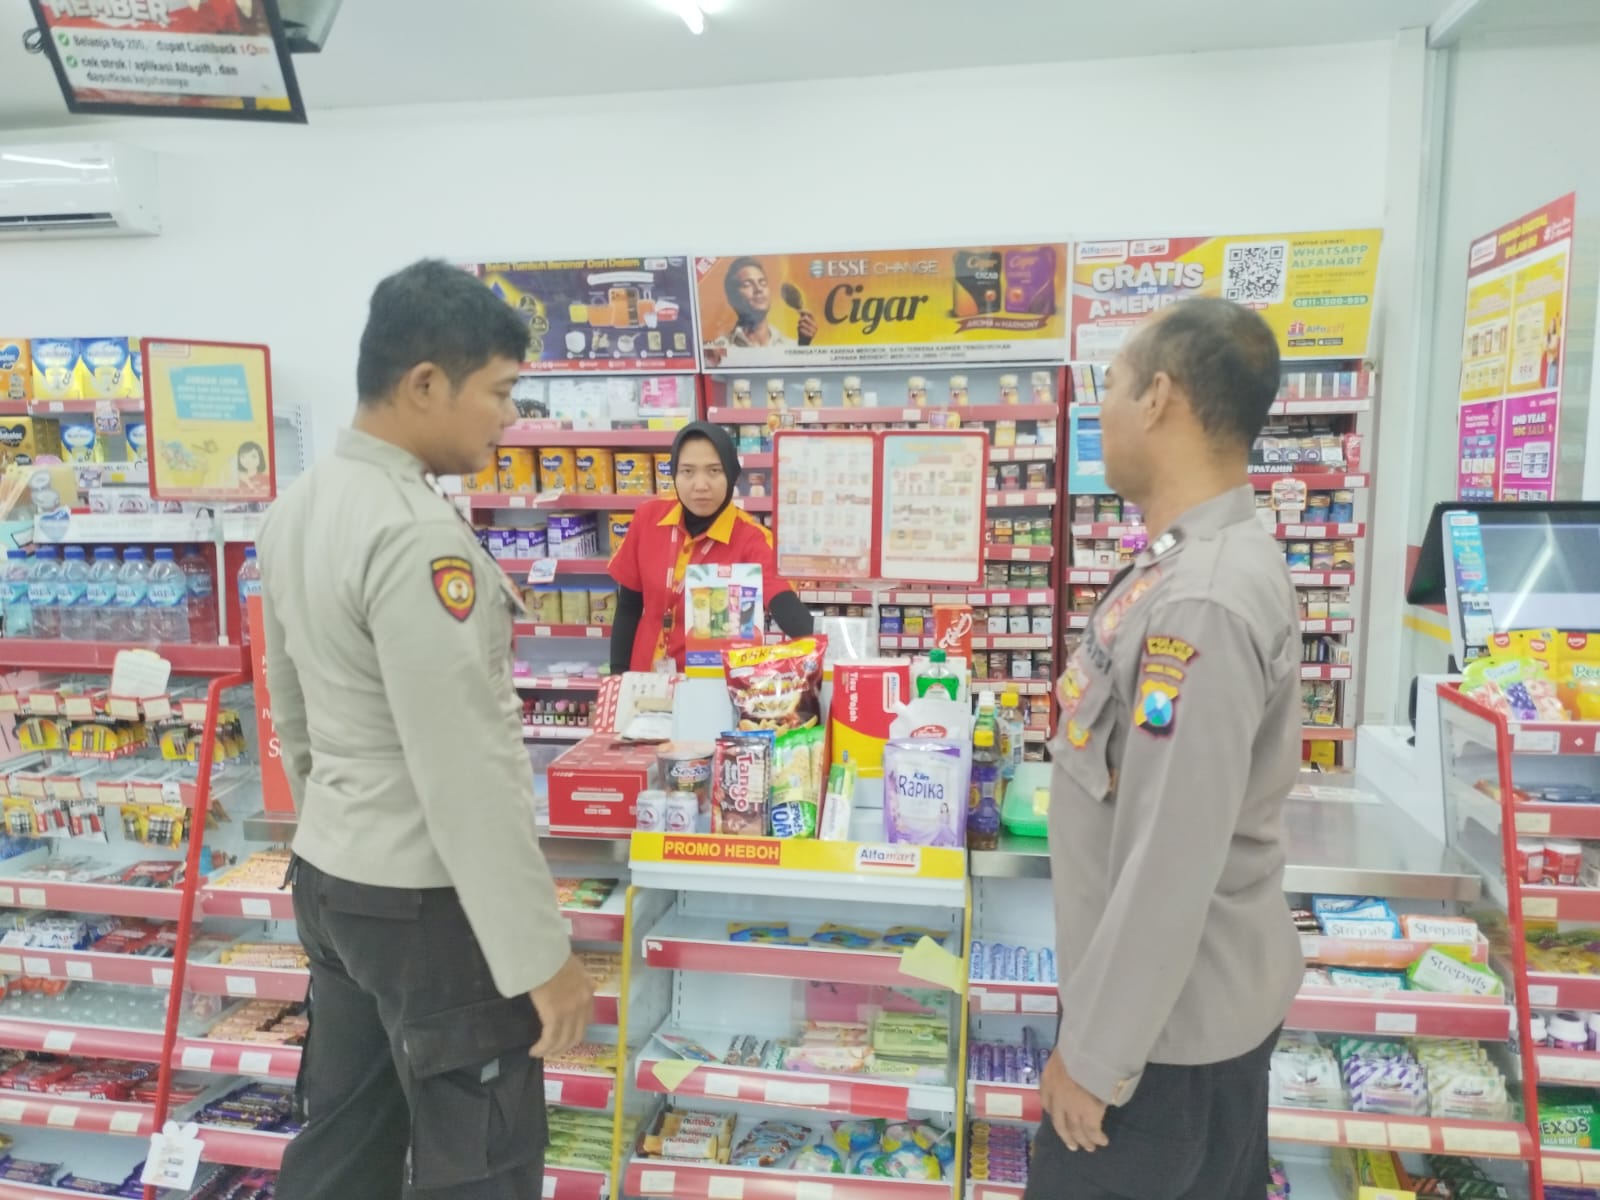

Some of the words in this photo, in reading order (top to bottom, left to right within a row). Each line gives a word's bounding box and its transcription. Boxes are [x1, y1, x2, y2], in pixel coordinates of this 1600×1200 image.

[52, 0, 169, 26] MEMBER
[1292, 245, 1368, 257] WHATSAPP
[827, 259, 869, 277] ESSE
[872, 260, 939, 275] CHANGE
[1291, 257, 1363, 269] ALFAMART
[1091, 262, 1205, 293] GRATIS
[824, 283, 929, 335] Cigar
[849, 672, 859, 691] Tisu
[849, 691, 859, 722] Wajah
[729, 751, 753, 812] Tango
[899, 774, 944, 800] Rapika
[663, 840, 721, 857] PROMO
[724, 843, 781, 860] HEBOH
[860, 848, 916, 864] Alfamart
[1331, 923, 1389, 939] Strepsils
[1414, 922, 1473, 938] Strepsils
[1429, 954, 1488, 991] Strepsils
